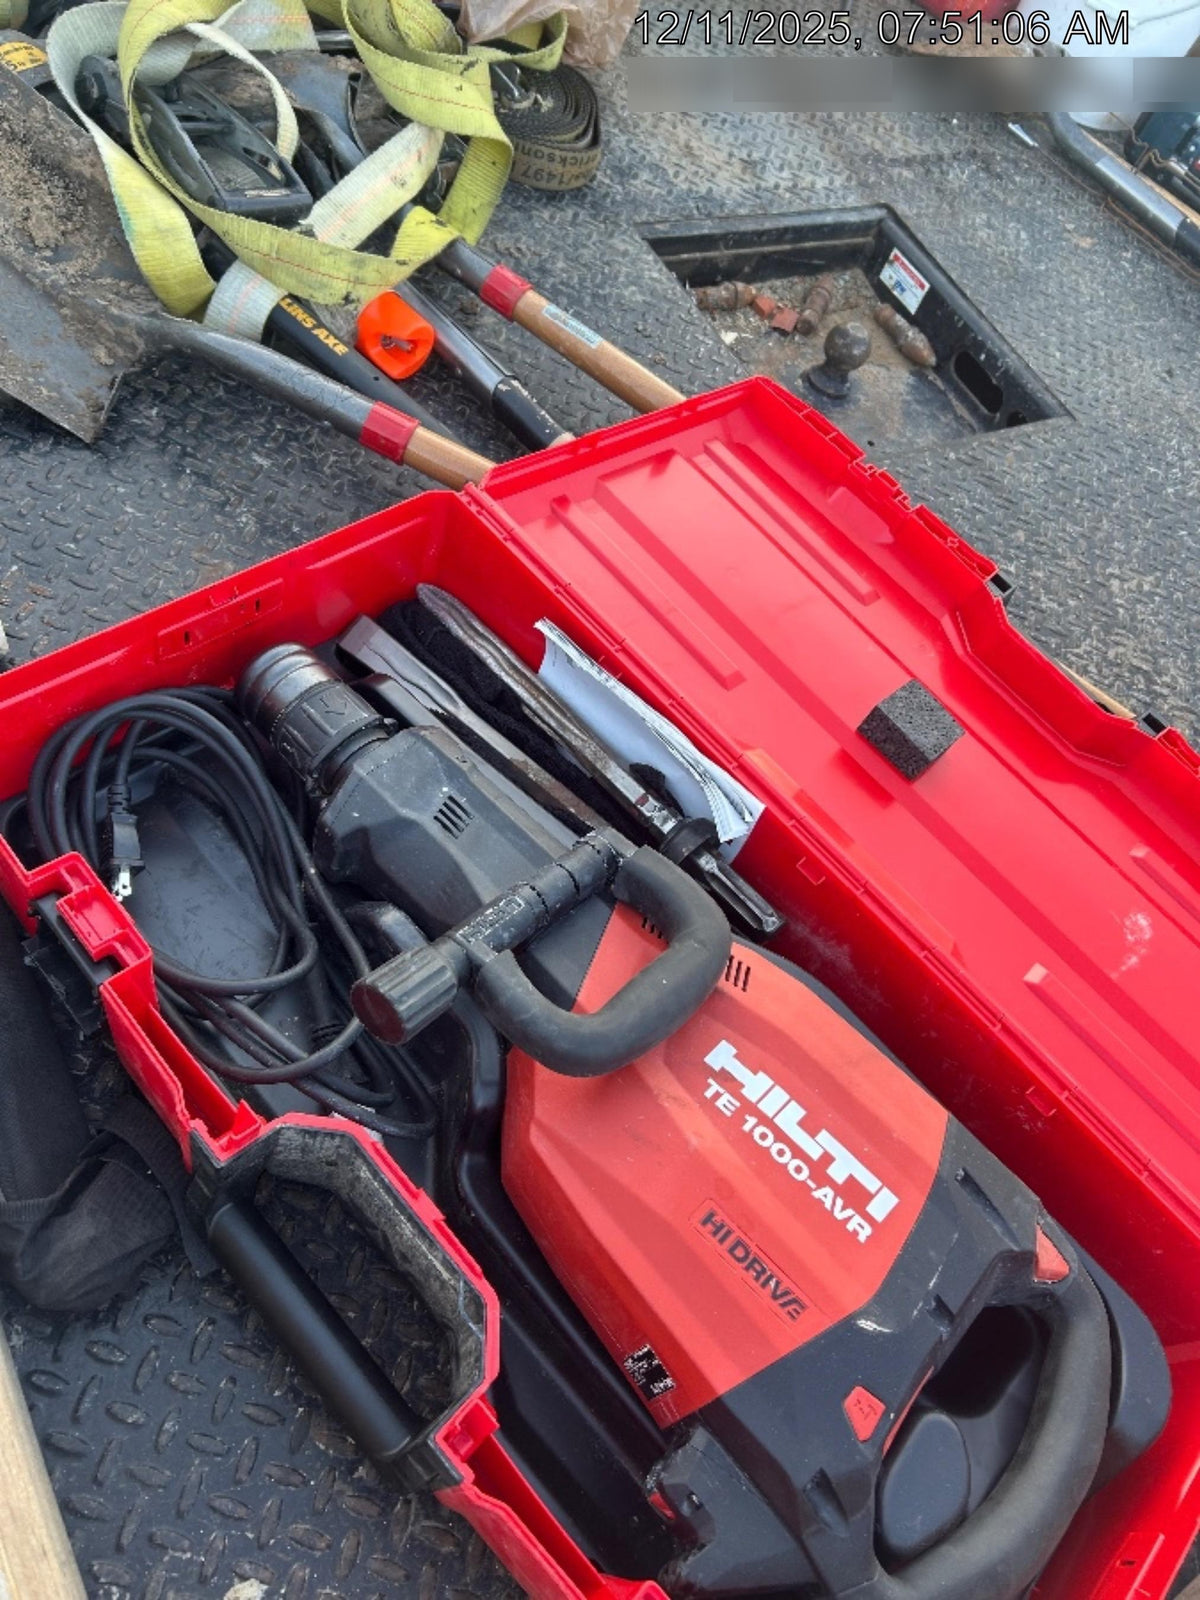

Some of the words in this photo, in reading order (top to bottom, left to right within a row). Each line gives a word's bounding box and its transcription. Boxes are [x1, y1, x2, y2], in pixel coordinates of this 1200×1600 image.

[311, 328, 350, 356] AXE
[703, 1039, 900, 1224] HILTI
[703, 1077, 742, 1118] TE
[741, 1113, 873, 1245] 1000-AVR
